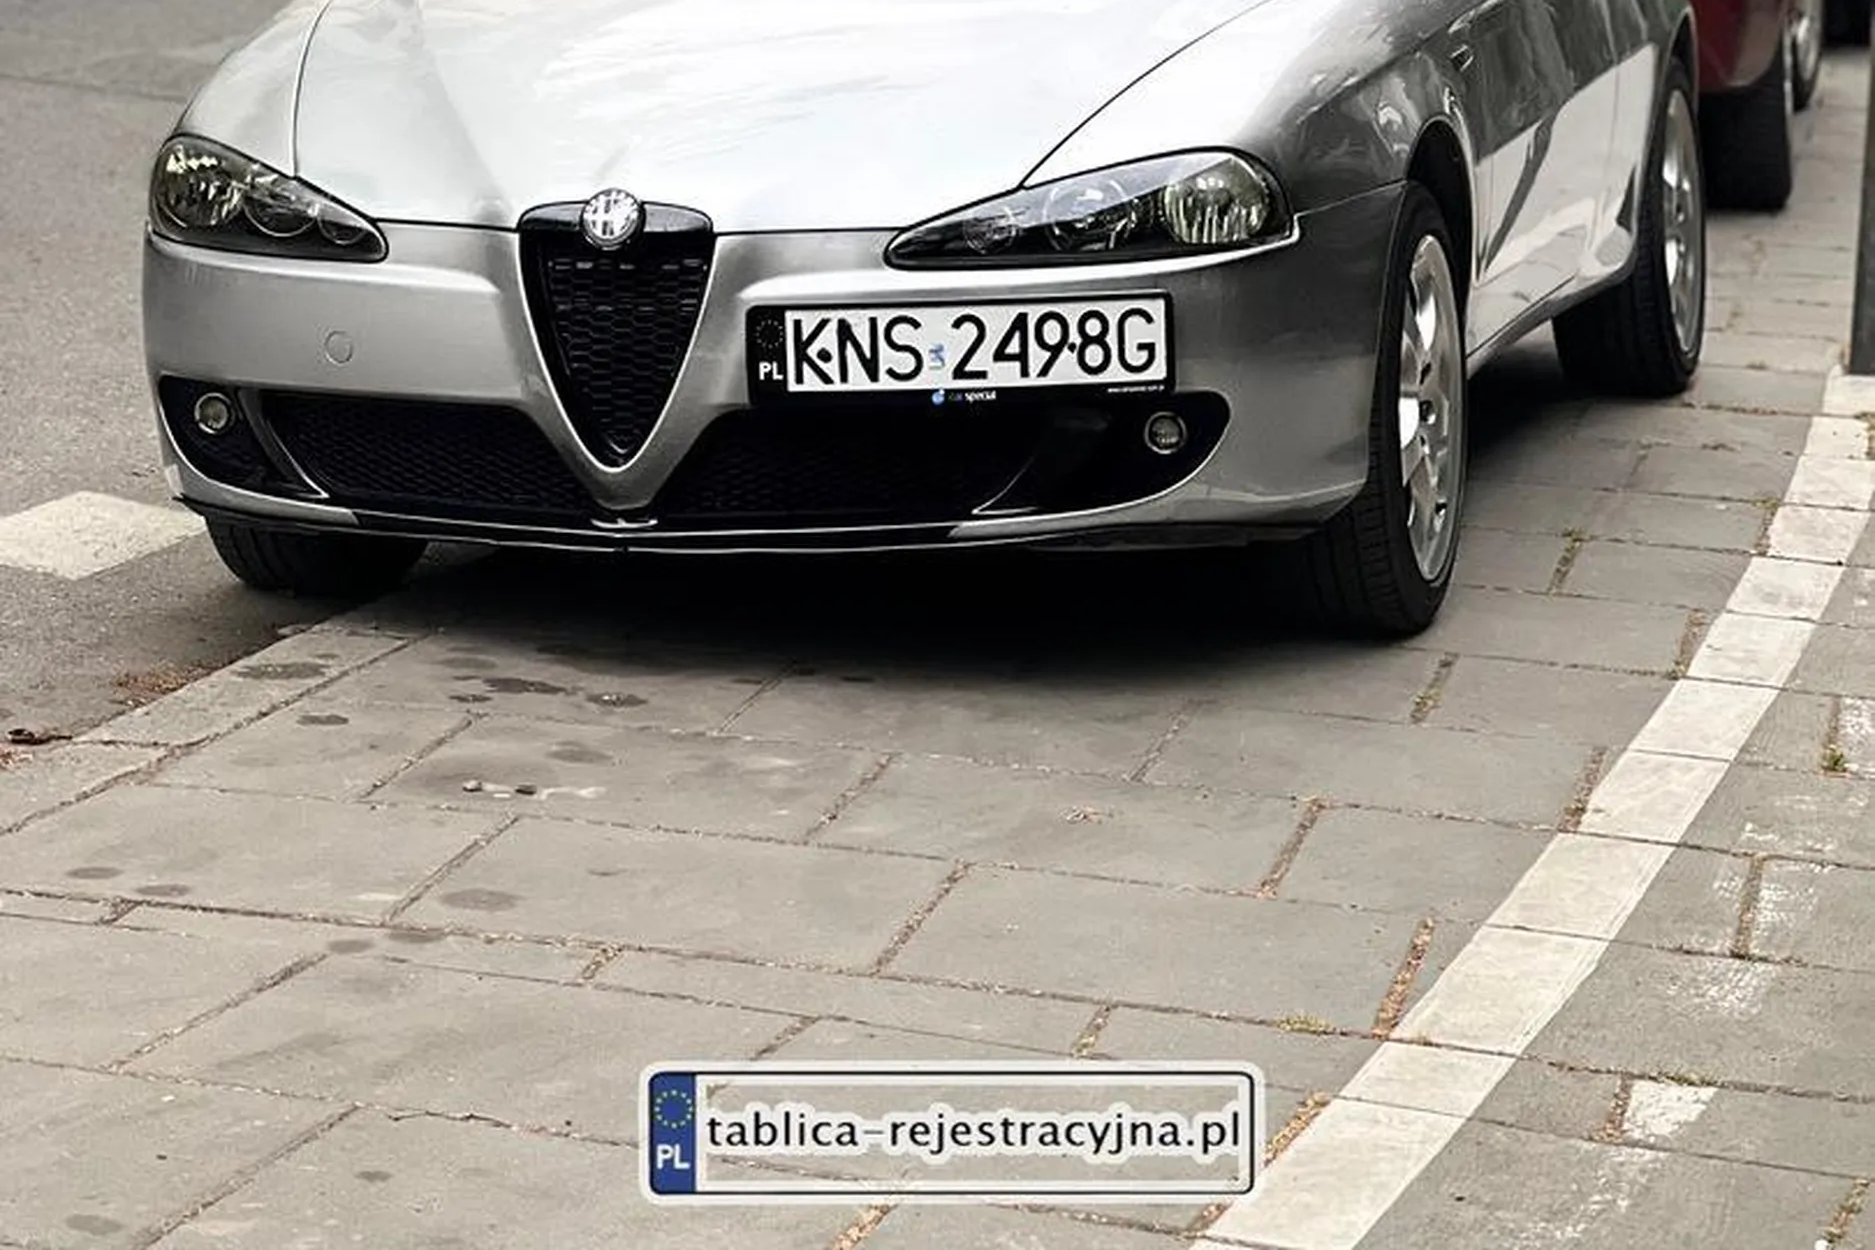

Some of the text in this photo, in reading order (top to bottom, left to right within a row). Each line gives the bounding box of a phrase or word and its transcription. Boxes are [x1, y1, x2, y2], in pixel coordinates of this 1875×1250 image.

[758, 360, 784, 381] PL
[792, 307, 1157, 385] KNS 2498G
